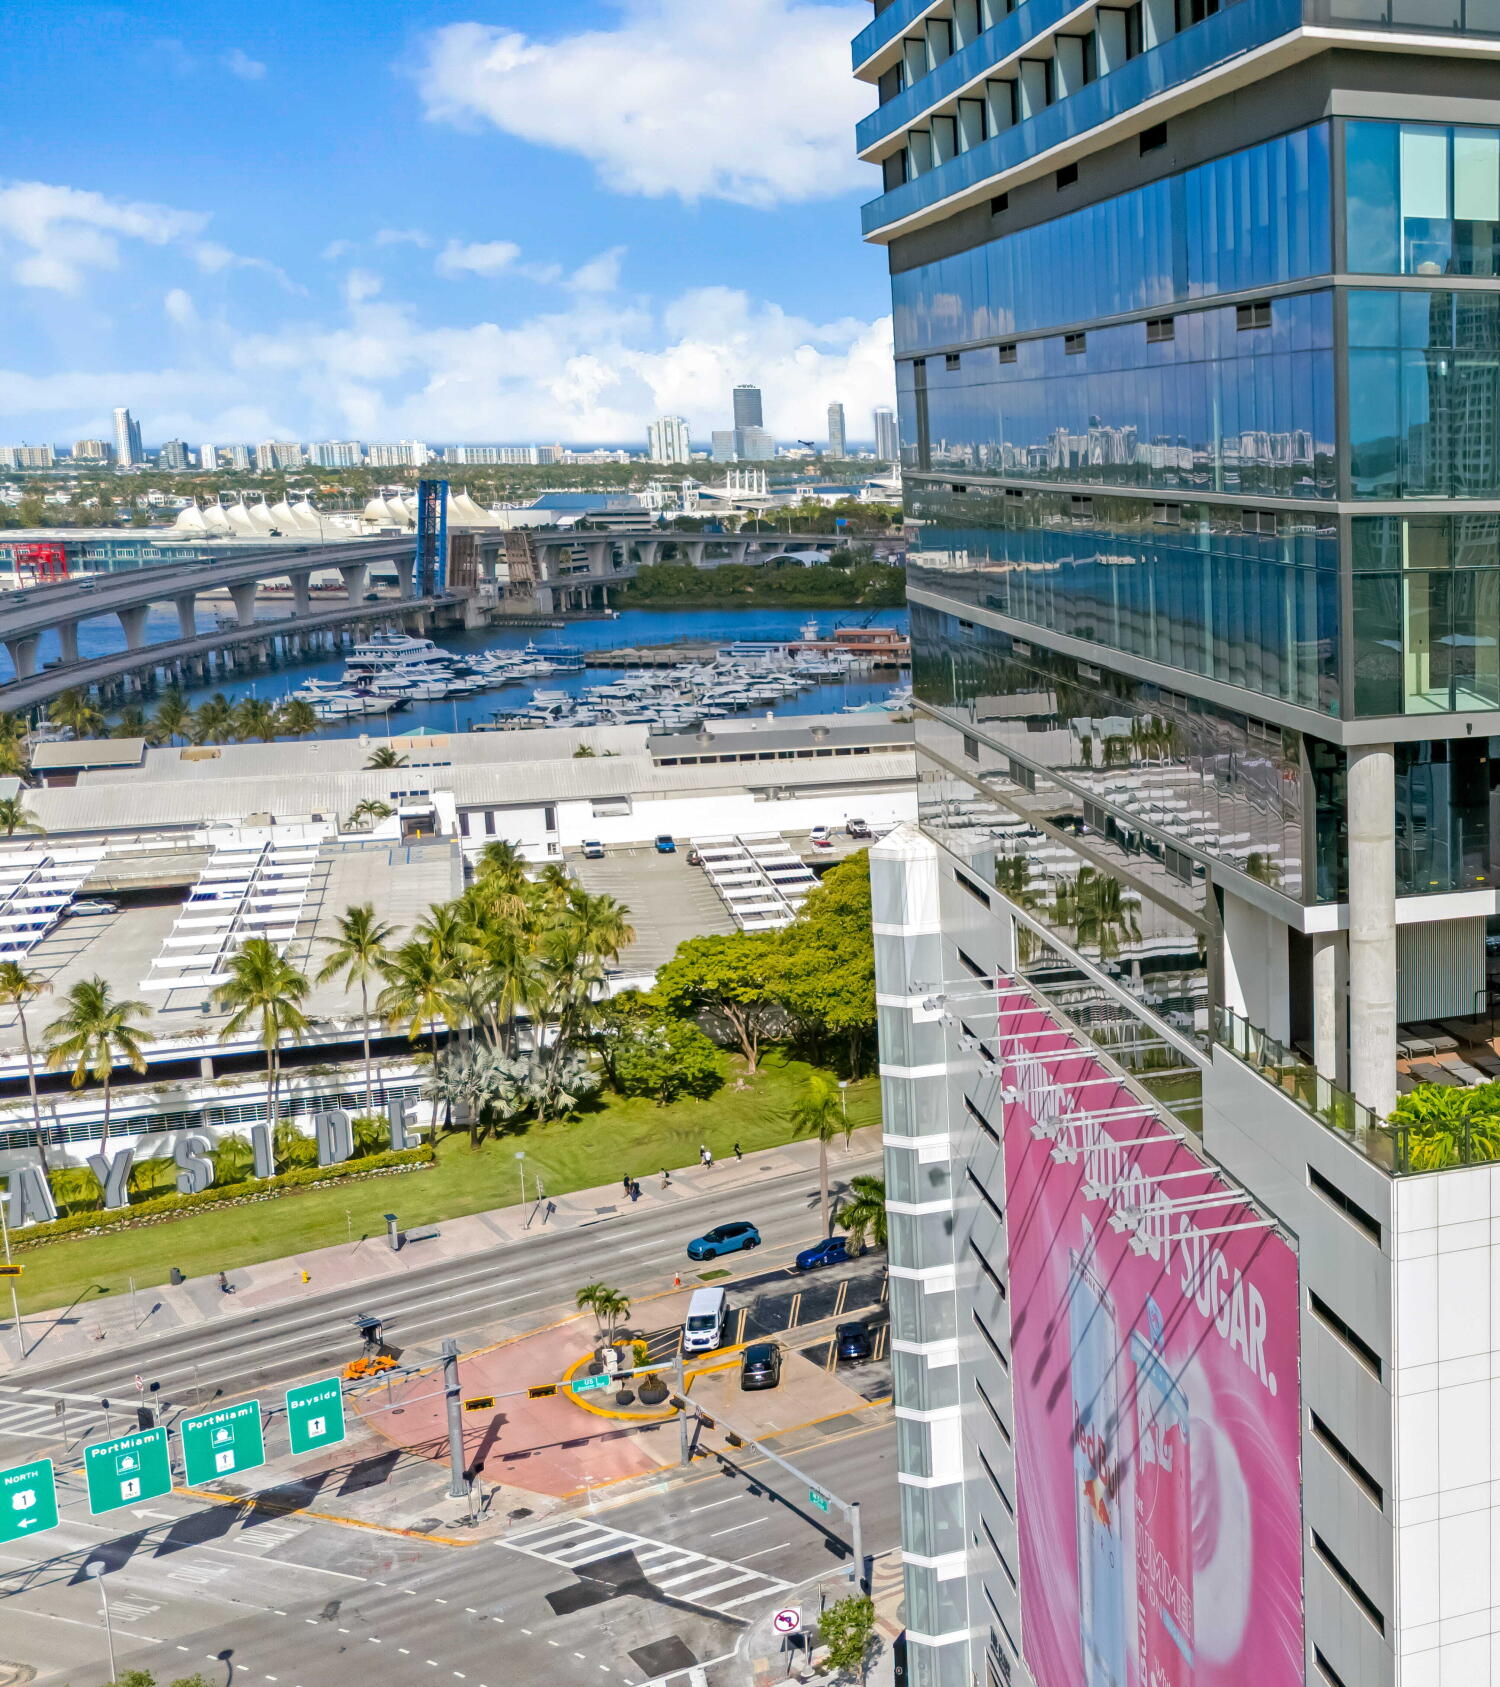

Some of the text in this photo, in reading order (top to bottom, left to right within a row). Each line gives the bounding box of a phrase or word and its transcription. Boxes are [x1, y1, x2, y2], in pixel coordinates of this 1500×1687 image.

[1081, 1107, 1173, 1276] WITHOUT
[1179, 1214, 1278, 1397] SUGAR.
[290, 1390, 338, 1409] Bayside
[4, 1469, 39, 1485] NORTH
[1097, 1433, 1120, 1505] Bull
[21, 1494, 27, 1506] 1
[233, 1522, 301, 1548] ONLY
[167, 1558, 237, 1584] ONLY
